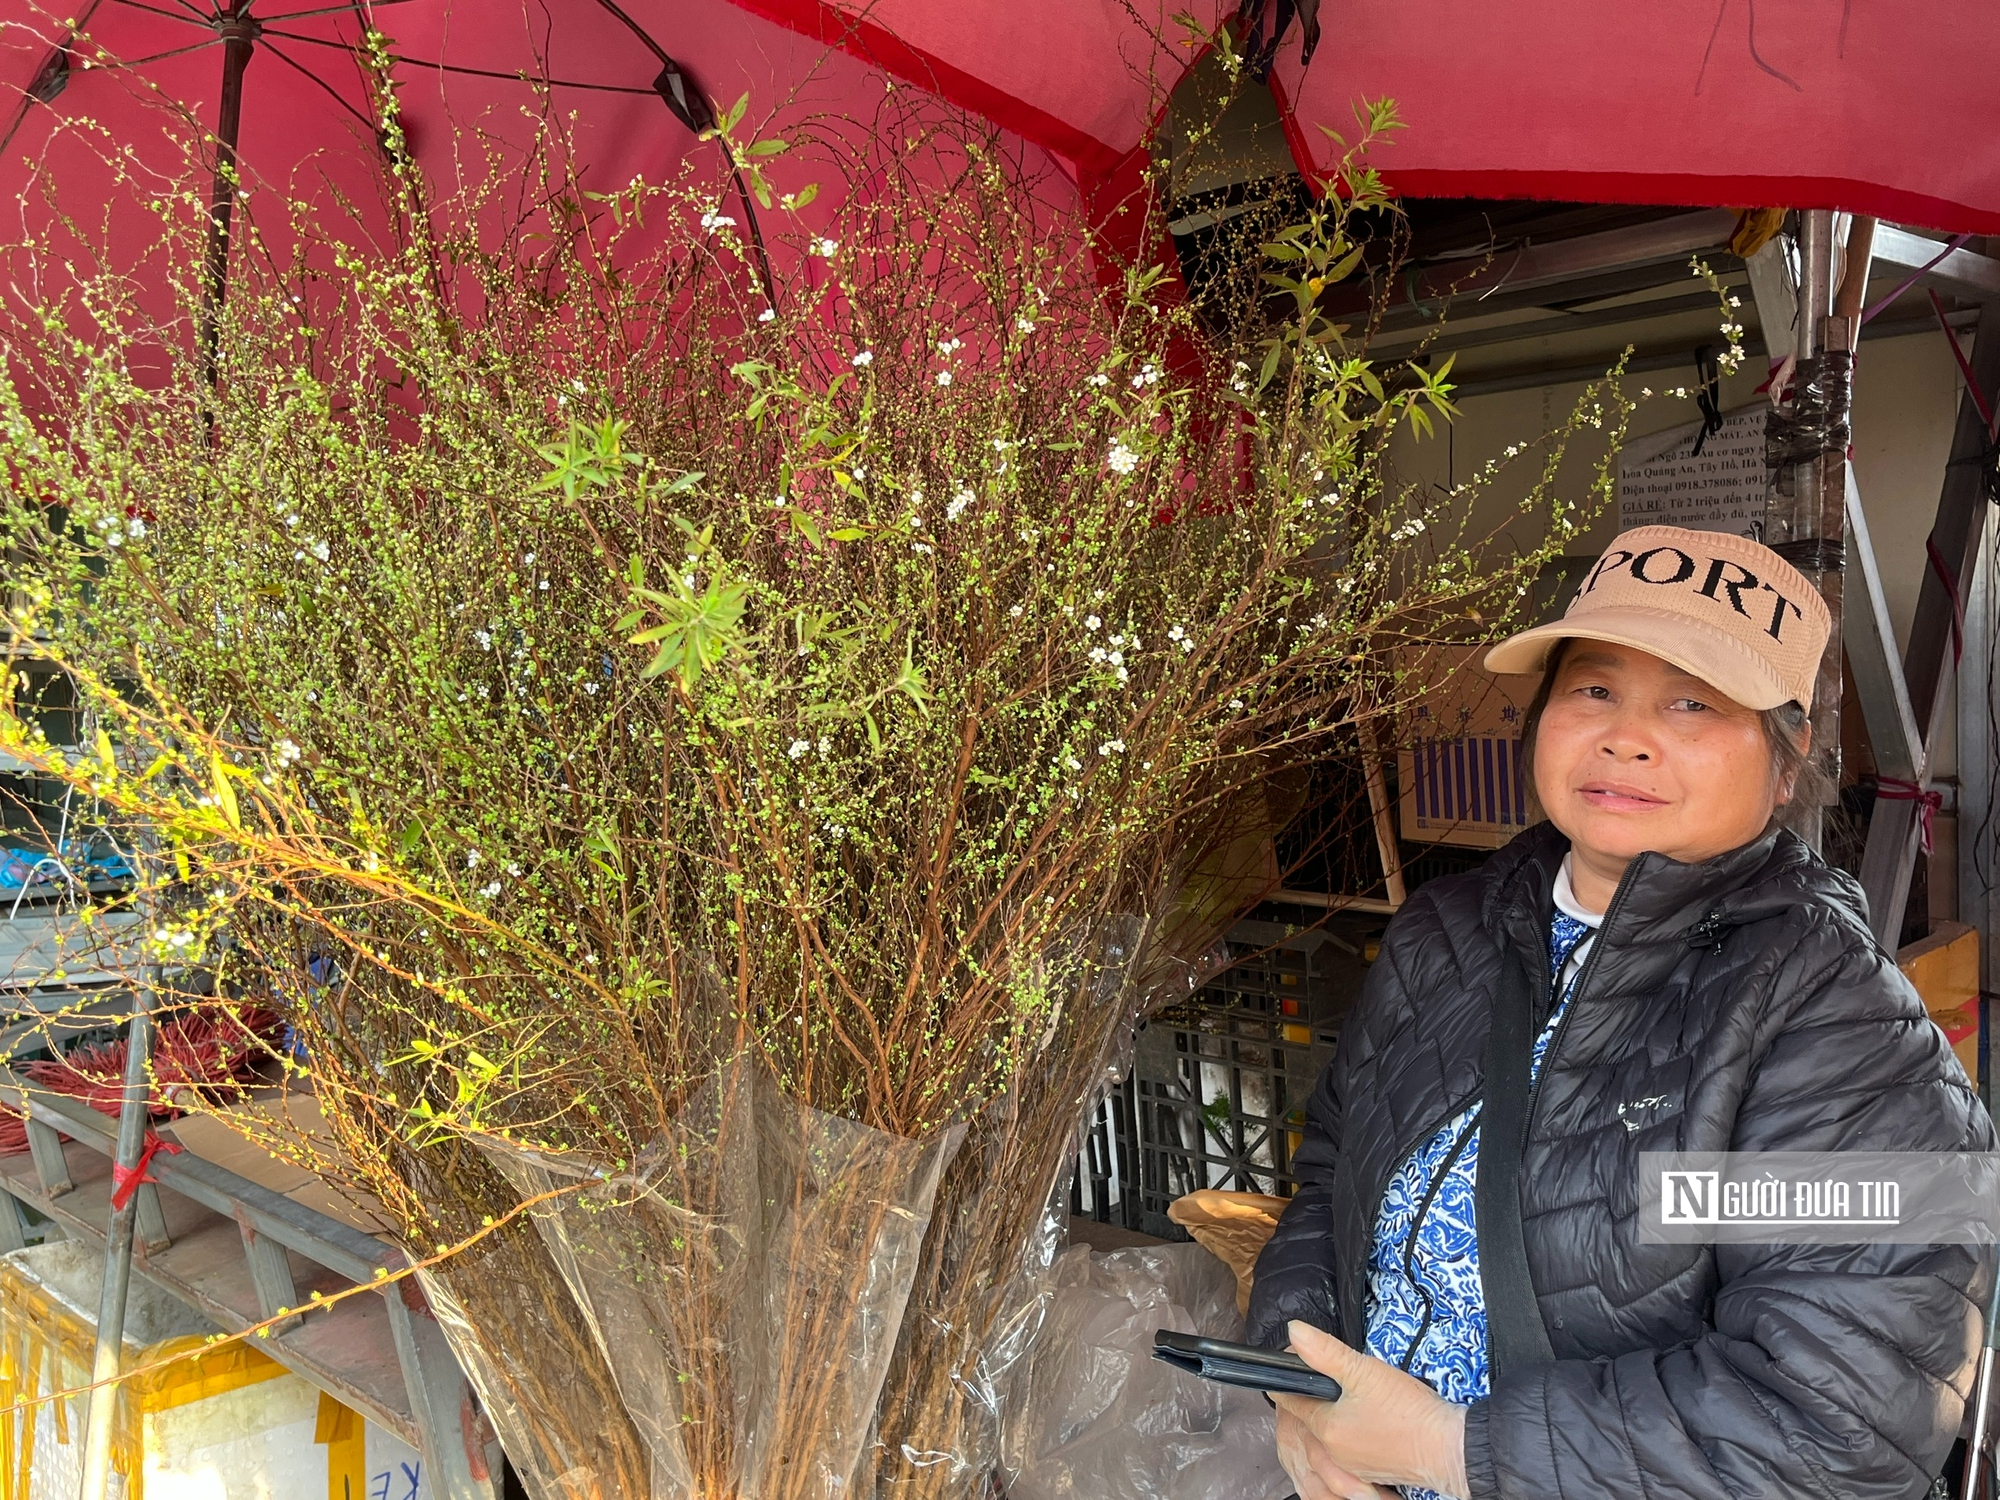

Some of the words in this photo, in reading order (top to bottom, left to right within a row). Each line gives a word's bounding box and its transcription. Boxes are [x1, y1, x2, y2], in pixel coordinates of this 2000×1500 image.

[1746, 428, 1759, 438] AN
[1731, 446, 1756, 457] ngay
[1698, 461, 1718, 474] Tây
[1741, 458, 1757, 469] Hà
[1647, 482, 1673, 495] thoại
[1622, 498, 1644, 512] GIÁ
[1669, 496, 1684, 509] Từ
[1686, 497, 1693, 508] 2
[1695, 495, 1720, 508] triệu
[1723, 491, 1742, 504] đến
[1656, 513, 1678, 526] điện
[1680, 511, 1706, 522] nước
[1708, 507, 1729, 523] đầy
